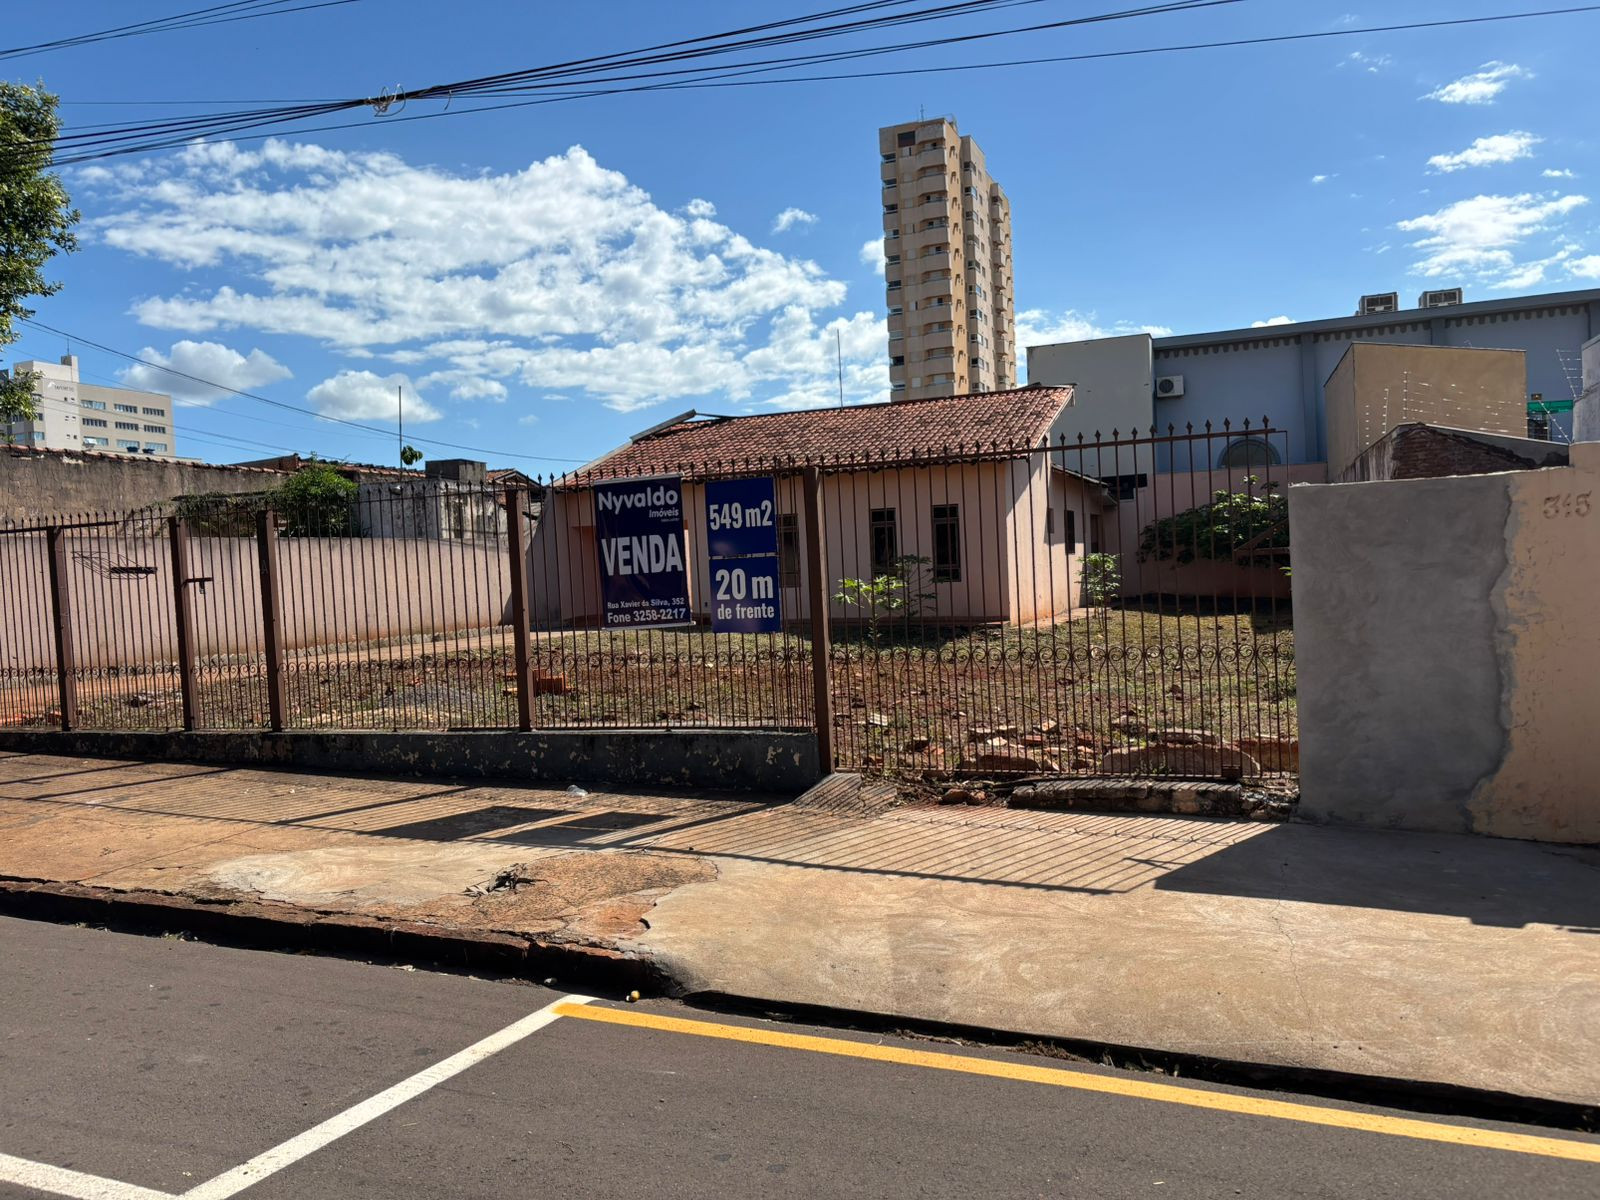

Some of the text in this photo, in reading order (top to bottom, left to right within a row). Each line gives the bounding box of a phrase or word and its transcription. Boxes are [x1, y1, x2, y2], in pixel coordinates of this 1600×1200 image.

[598, 486, 679, 515] Nyvaldo
[648, 507, 680, 518] Imóveis
[709, 499, 773, 531] 549 m2
[601, 533, 684, 576] VENDA
[715, 568, 774, 601] 20 m
[607, 601, 620, 609] Rua
[620, 600, 641, 608] Xavier
[650, 599, 671, 607] Silva,
[671, 597, 685, 605] 352
[717, 603, 775, 620] de frente
[607, 608, 686, 624] Fone 3258-2217
